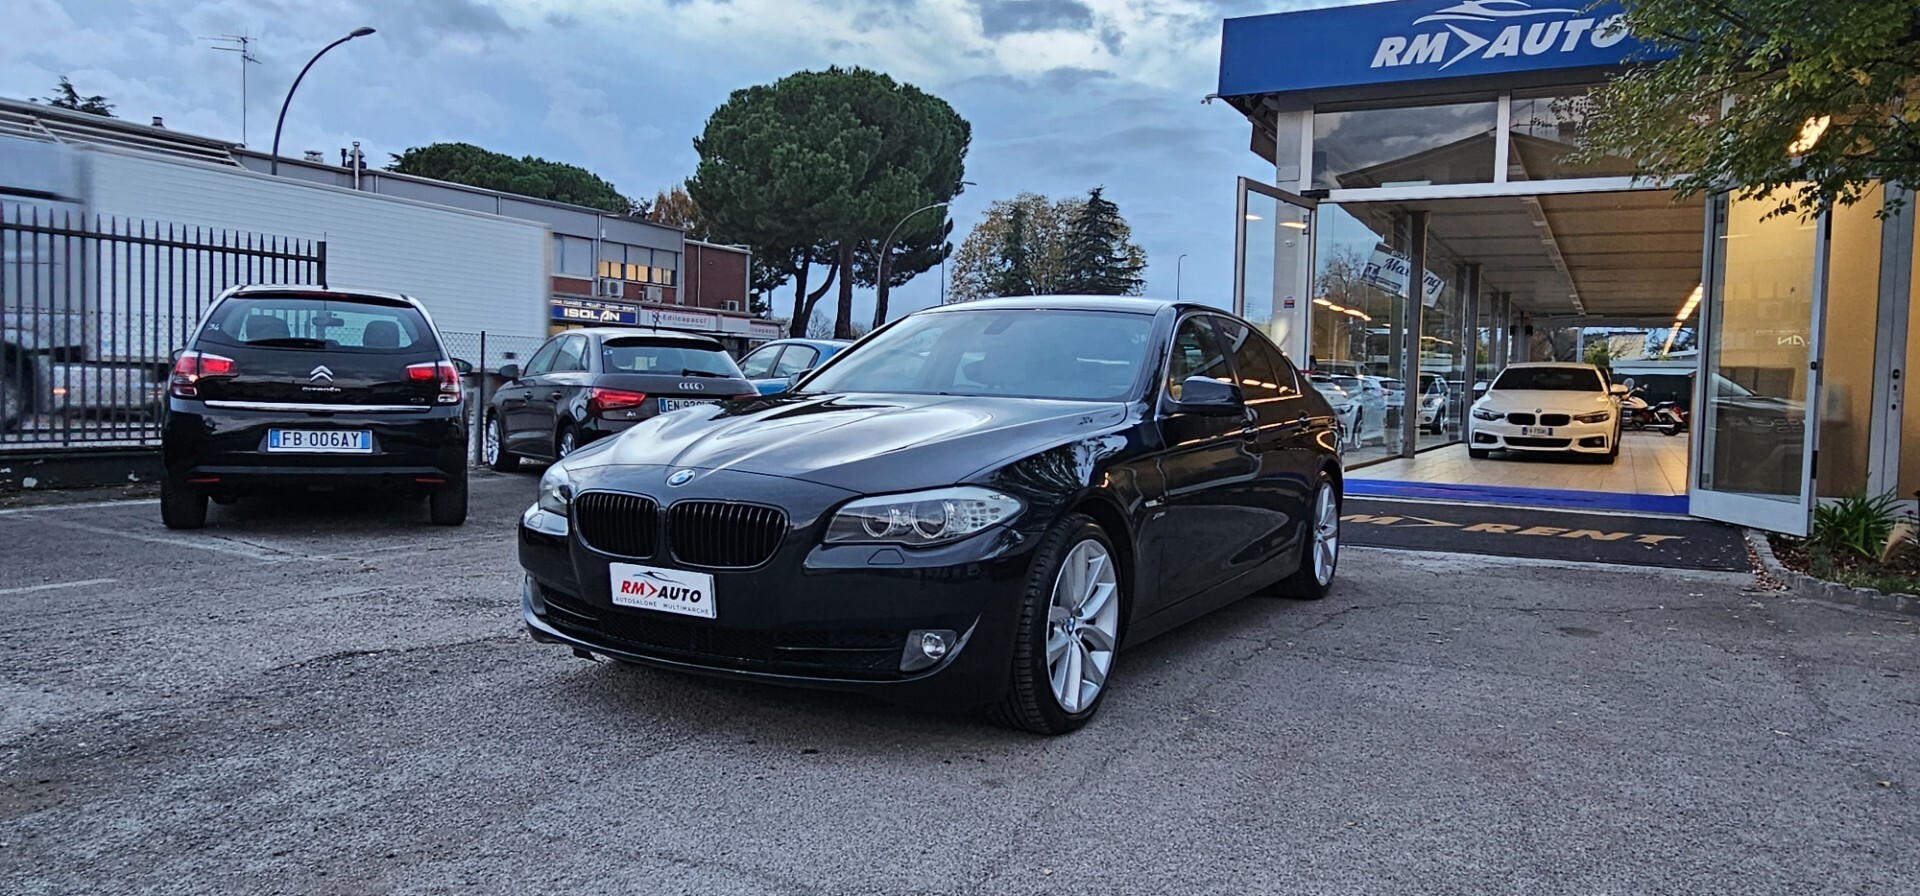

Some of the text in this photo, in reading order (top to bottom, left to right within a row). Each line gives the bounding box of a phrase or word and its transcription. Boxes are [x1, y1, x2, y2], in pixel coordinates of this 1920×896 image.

[1481, 14, 1632, 59] AUTO
[564, 308, 620, 322] ISOLAN
[667, 400, 680, 411] EN
[282, 431, 360, 447] FB 006AY
[1460, 523, 1685, 544] RENT
[657, 585, 702, 603] AUTO
[615, 596, 709, 615] AUTOSALONE MULTIMARCHE
